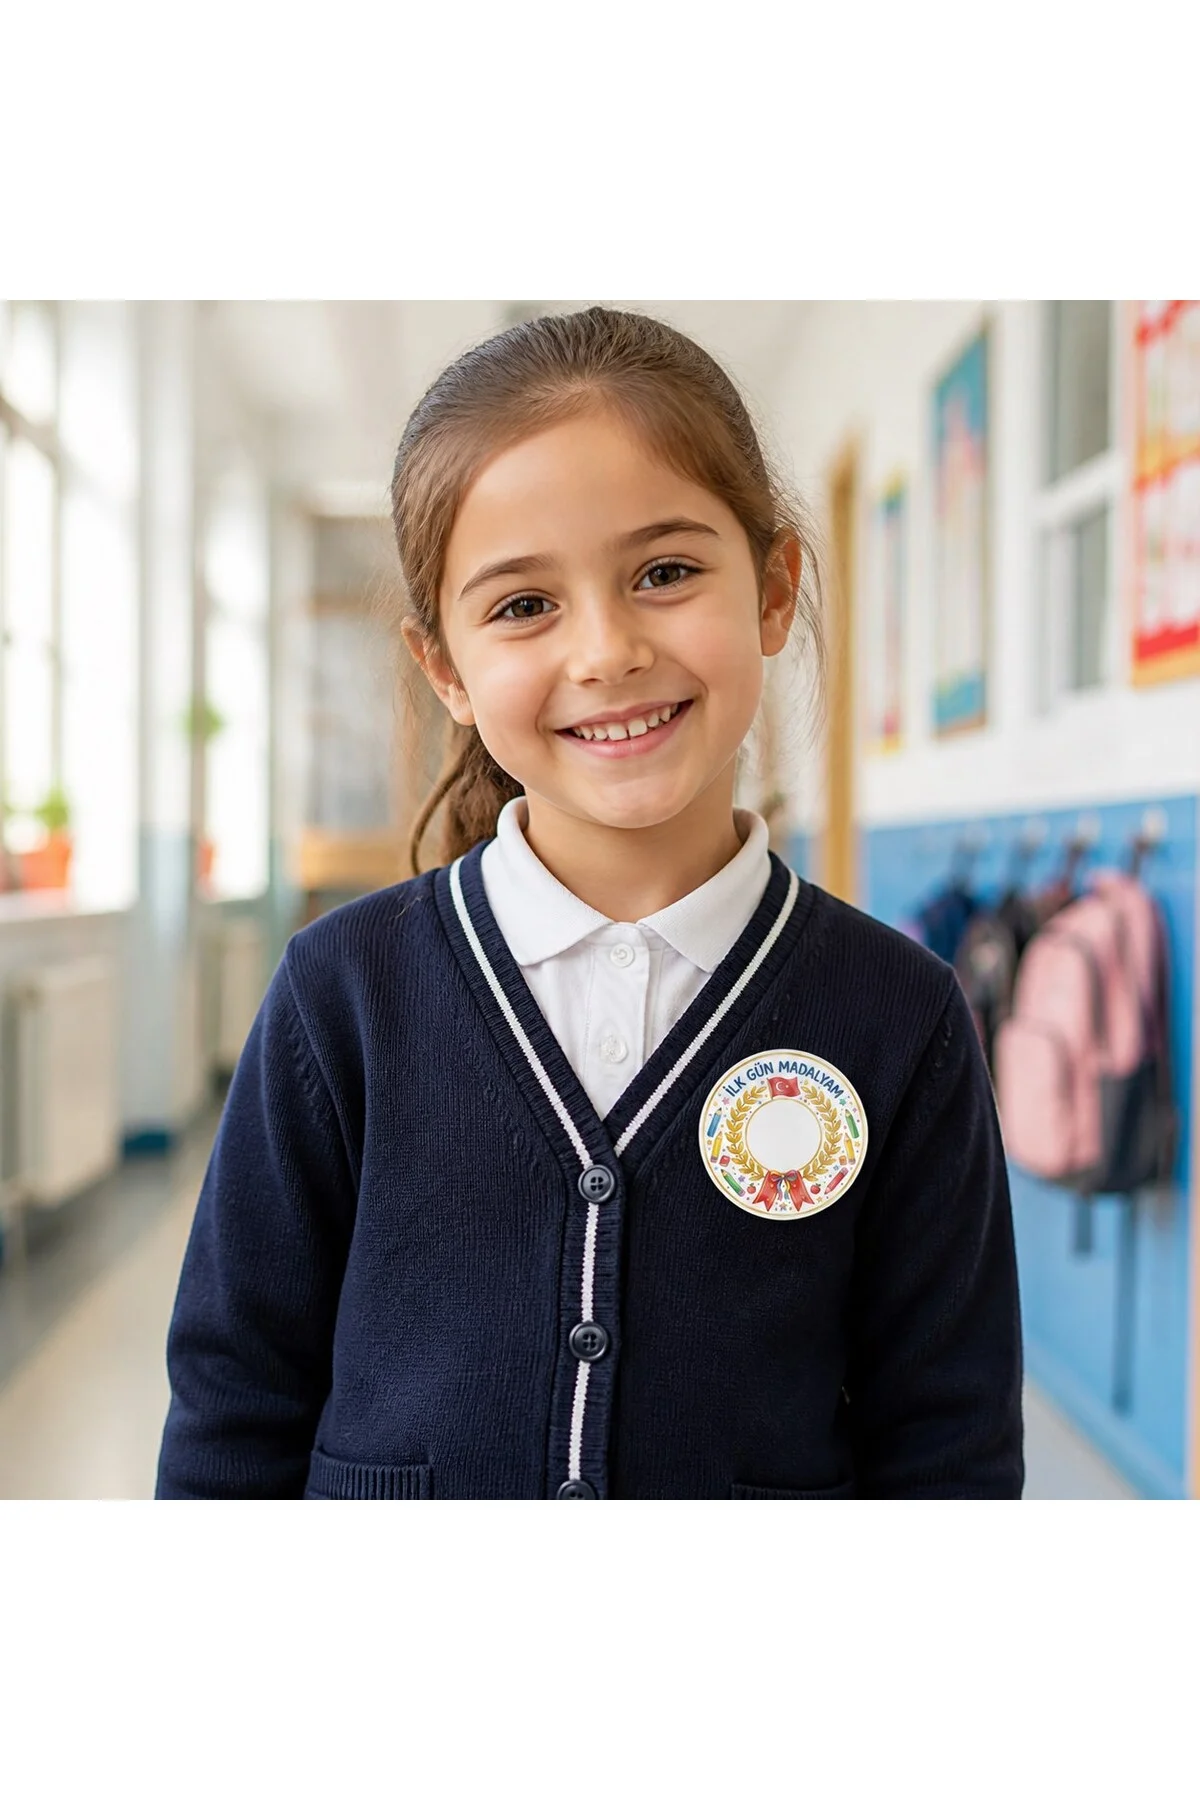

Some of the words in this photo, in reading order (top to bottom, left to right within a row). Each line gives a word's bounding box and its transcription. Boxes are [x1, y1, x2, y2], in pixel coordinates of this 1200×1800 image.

[723, 1076, 746, 1097] İLK
[746, 1062, 774, 1080] GÜN
[779, 1061, 844, 1098] MADALYAM
